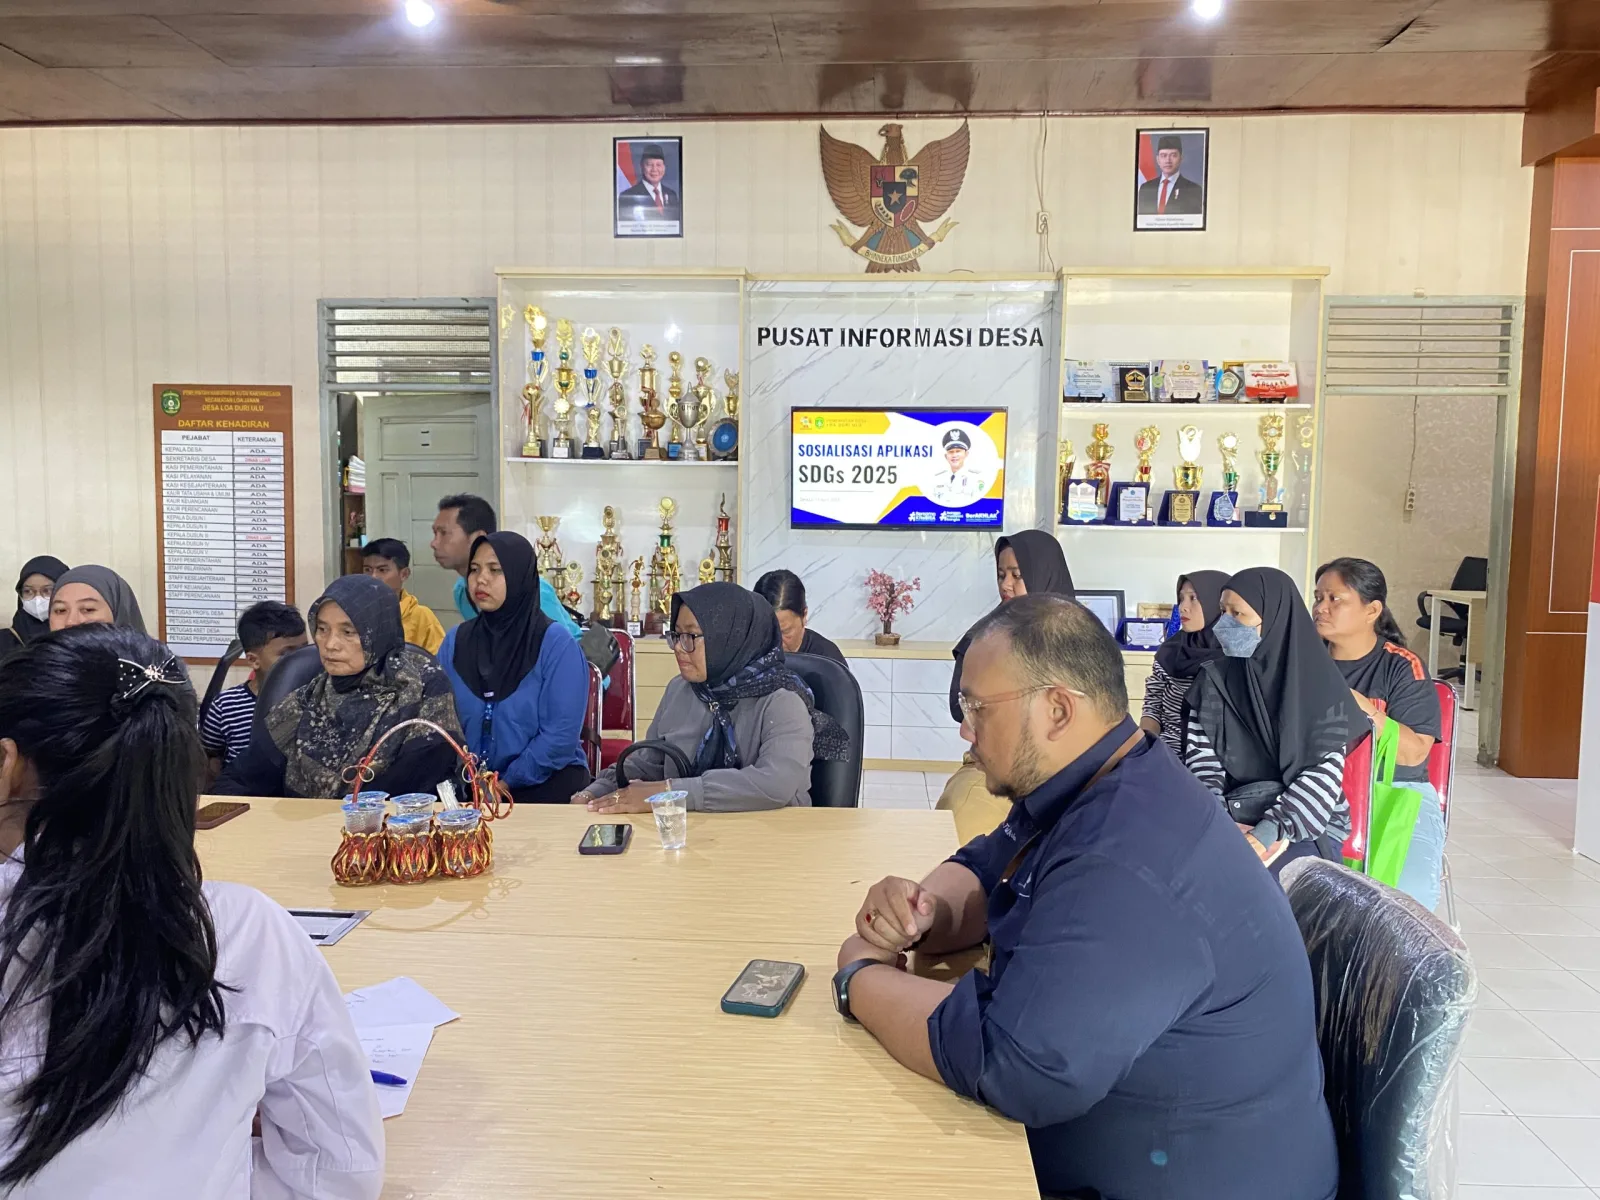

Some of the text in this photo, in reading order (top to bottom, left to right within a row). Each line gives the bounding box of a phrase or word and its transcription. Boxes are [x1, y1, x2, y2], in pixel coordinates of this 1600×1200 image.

[758, 327, 1043, 347] PUSAT INFORMASI DESA
[178, 420, 269, 428] DAFTAR KEHADIRAN
[798, 444, 933, 458] SOSIALISASI APLIKASI
[799, 465, 897, 484] SDGs 2025
